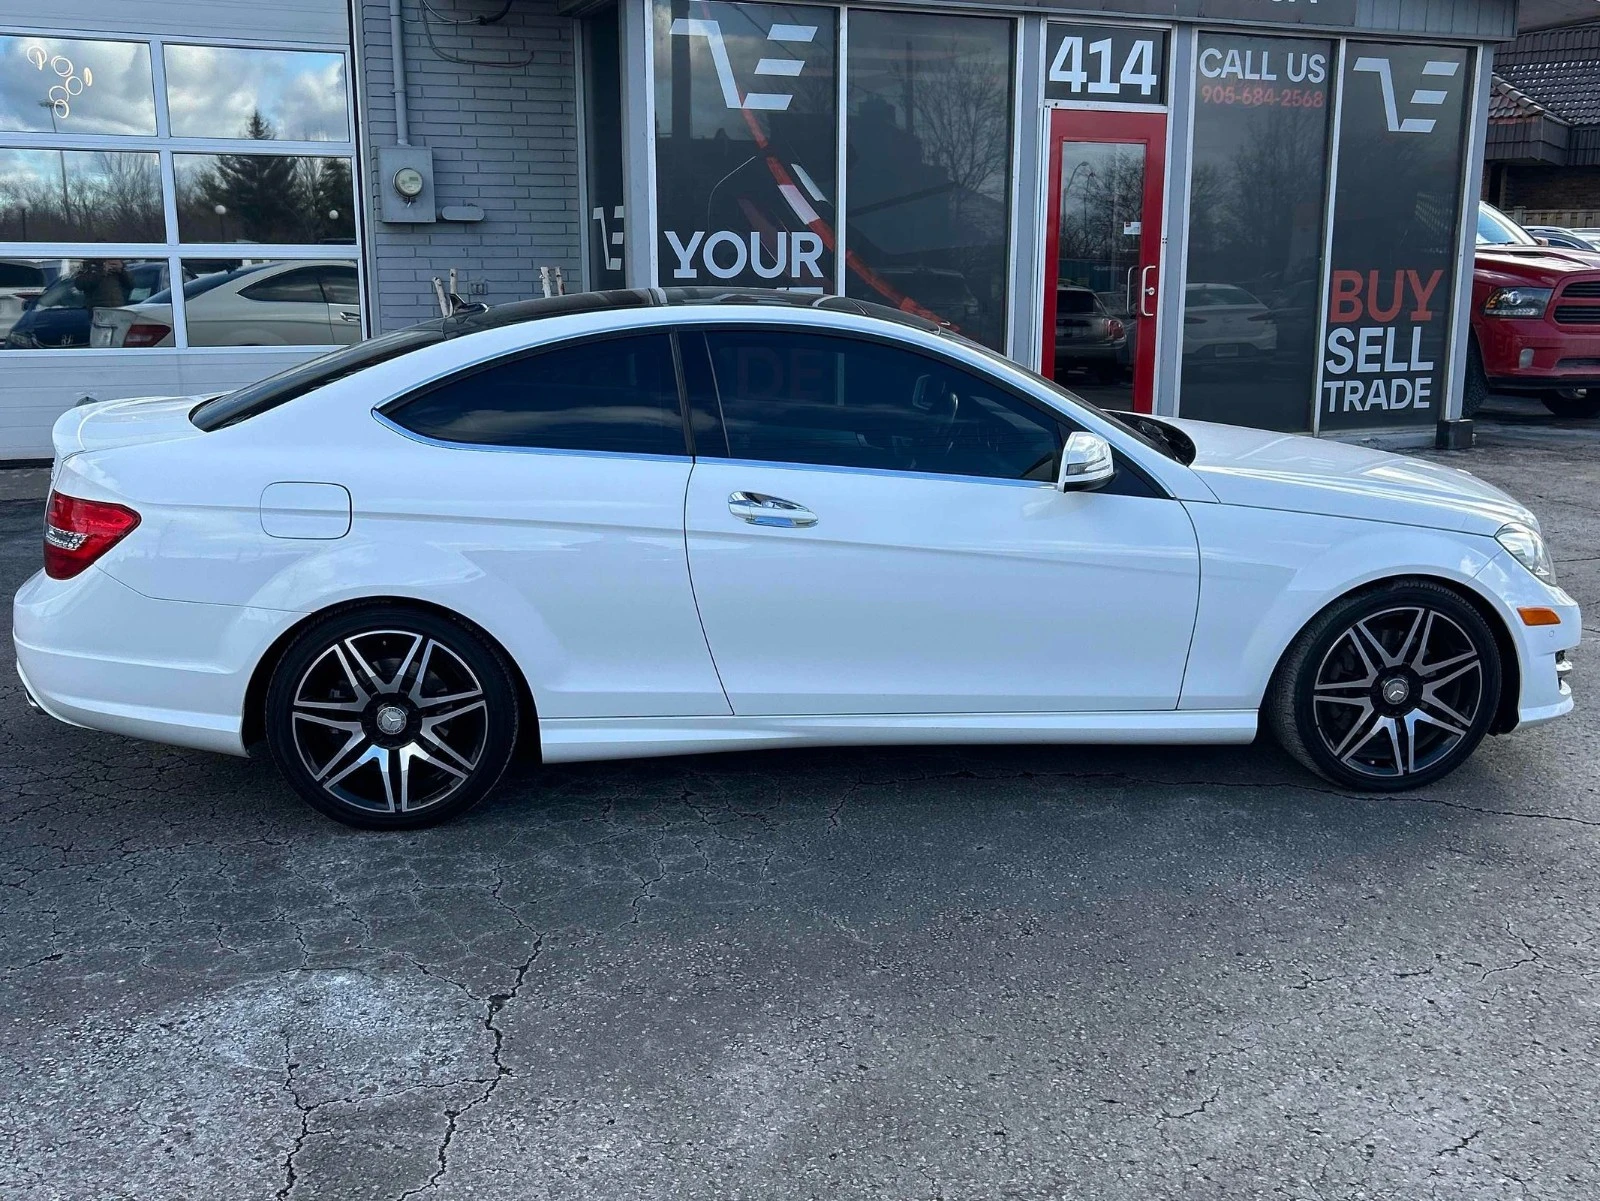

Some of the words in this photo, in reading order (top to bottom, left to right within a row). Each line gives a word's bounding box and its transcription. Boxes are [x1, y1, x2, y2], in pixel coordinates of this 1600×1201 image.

[1049, 36, 1157, 96] 414
[1199, 48, 1277, 81] CALL
[1287, 53, 1326, 84] US
[1201, 84, 1324, 108] 905-684-2568
[664, 230, 824, 279] YOUR
[1329, 269, 1444, 323] BUY
[1325, 326, 1434, 375] SELL
[1323, 377, 1432, 413] TRADE
